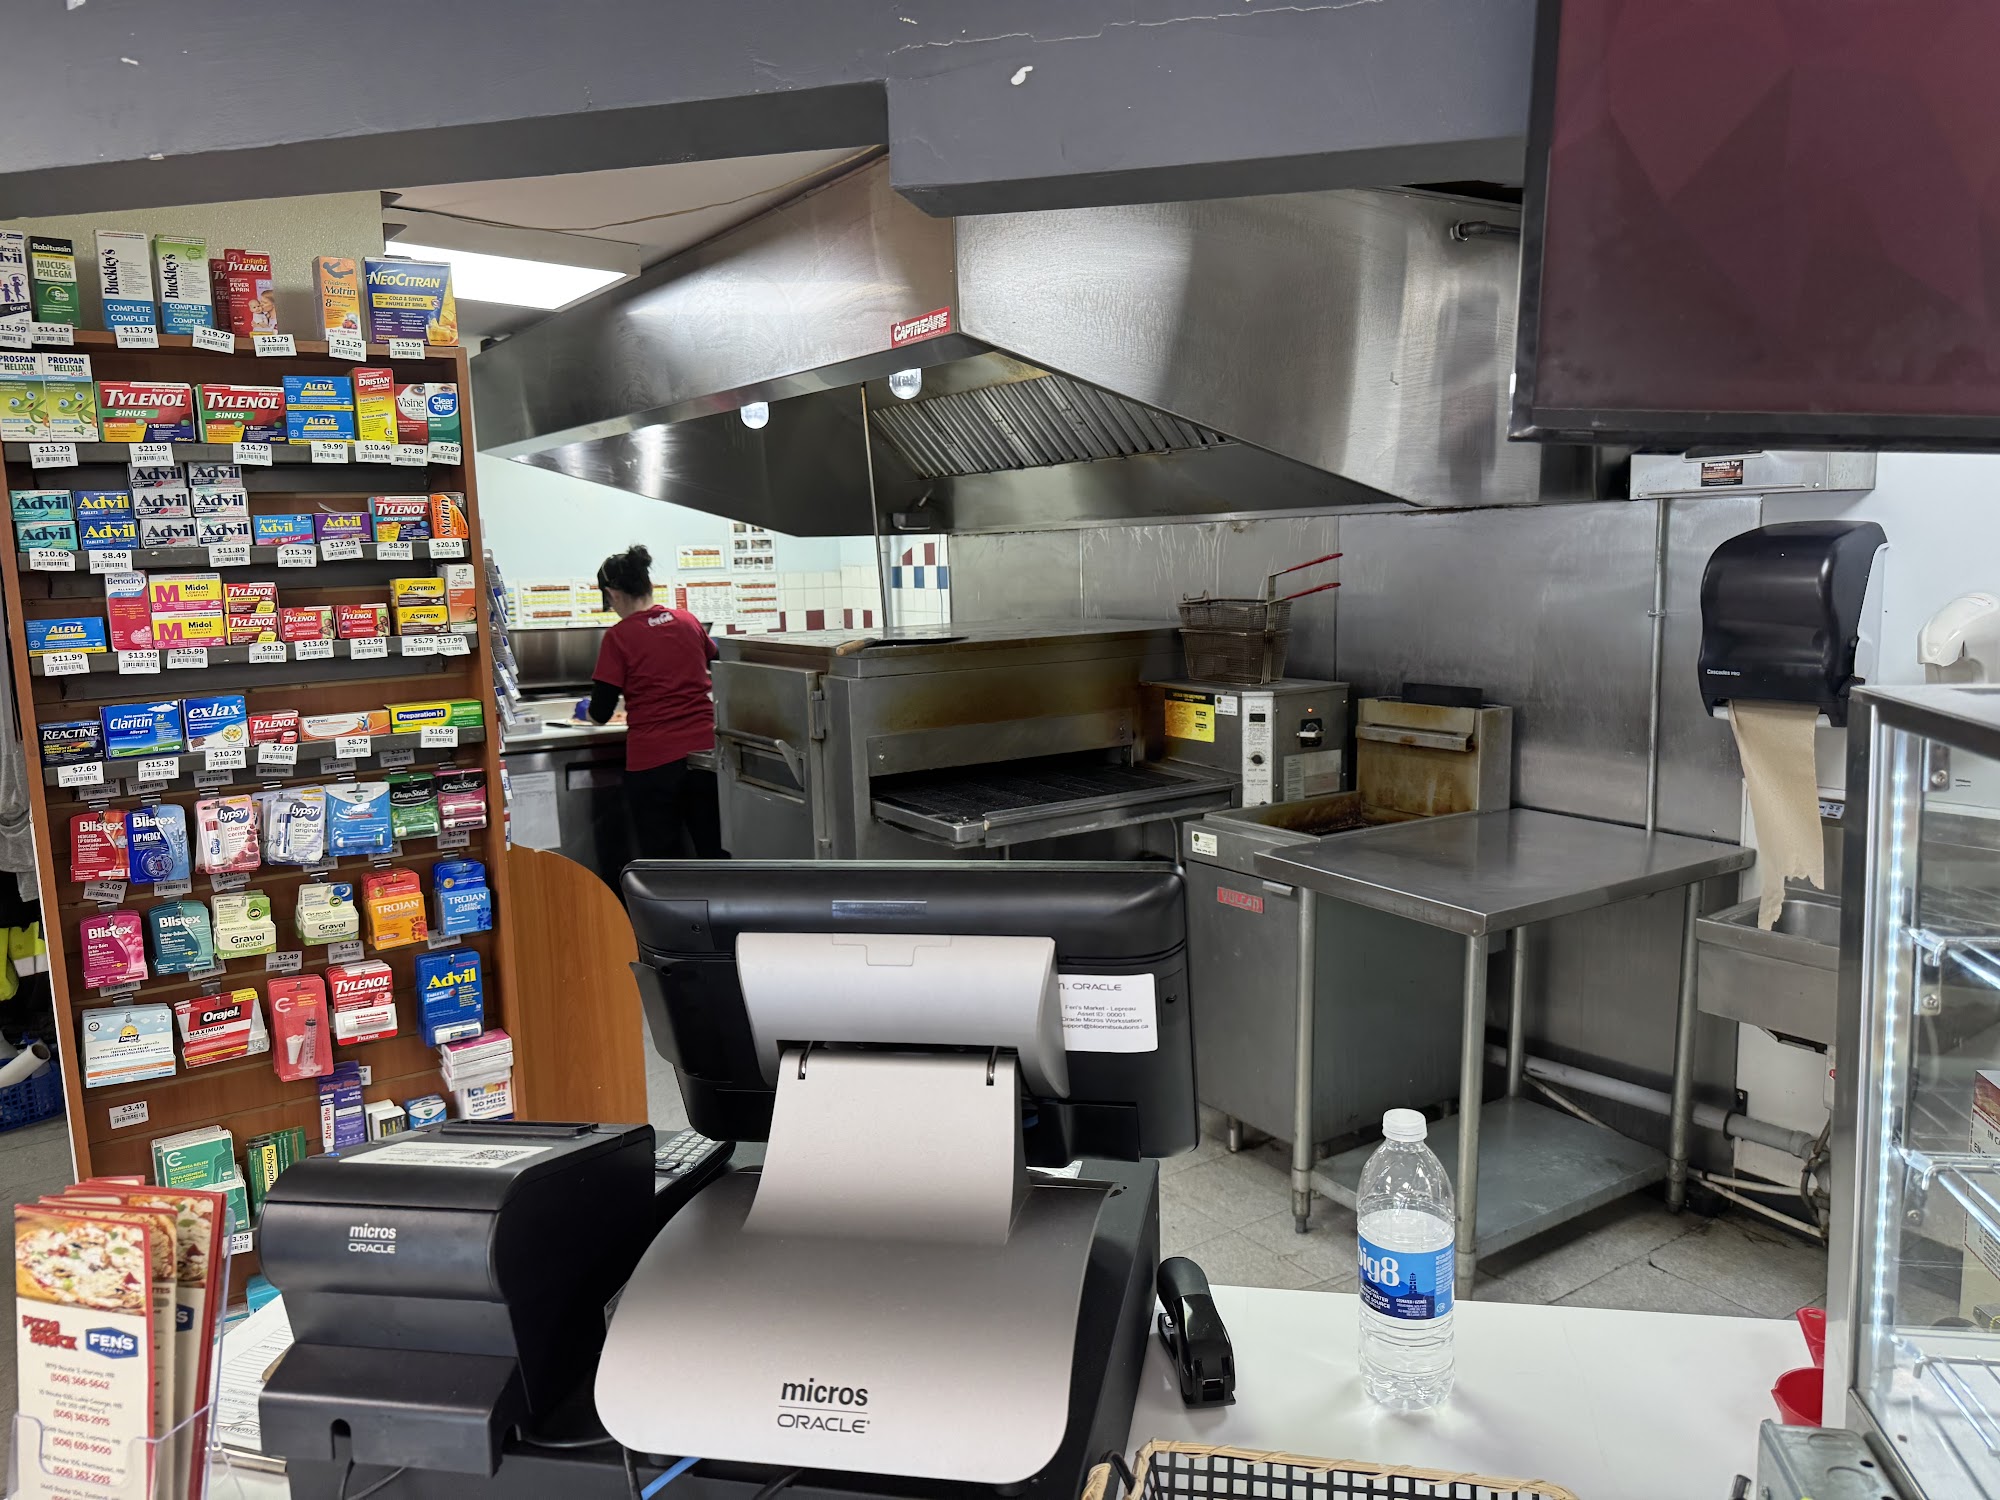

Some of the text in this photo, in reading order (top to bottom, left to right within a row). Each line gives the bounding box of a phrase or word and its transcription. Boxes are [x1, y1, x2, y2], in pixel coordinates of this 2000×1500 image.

[32, 243, 72, 253] Robitussin
[37, 260, 66, 270] MUCUS
[227, 261, 269, 272] TYLENOL
[38, 269, 72, 279] PHLEGM
[102, 249, 119, 295] Buckley's
[160, 254, 179, 299] Buckley's
[324, 286, 356, 296] Motrin
[107, 304, 151, 313] COMPLETE
[169, 303, 207, 311] COMPLETE
[111, 314, 150, 323] COMPLET
[172, 317, 206, 325] COMPLET
[124, 326, 153, 334] $13.79
[202, 329, 231, 340] $19.79
[336, 340, 362, 348] $13.29
[47, 356, 85, 365] PROSPAN
[4, 363, 35, 371] HELIXIA
[53, 364, 83, 372] HELIXIA
[303, 381, 334, 392] ALEVE
[358, 377, 390, 387] DRISTAN
[104, 389, 185, 407] TYLENOL
[205, 392, 279, 410] TYLENOL
[397, 397, 424, 408] Visine
[431, 396, 454, 405] Clear
[434, 403, 453, 412] eyes
[306, 416, 337, 425] ALEVE
[133, 466, 182, 480] Advil
[193, 466, 240, 479] Advil
[14, 496, 69, 509] Advil
[78, 495, 130, 509] Advil
[138, 493, 189, 507] Advil
[197, 494, 244, 506] Advil
[376, 503, 426, 515] TYLENOL
[322, 515, 361, 527] Advil
[440, 499, 451, 537] Motrin
[83, 524, 137, 538] Advil
[145, 523, 196, 538] Advil
[203, 523, 249, 536] Advil
[258, 522, 294, 533] Advil
[20, 527, 72, 540] Advil
[330, 540, 356, 549] $17.99
[107, 577, 144, 588] Benadryl
[185, 583, 209, 591] Midol
[155, 584, 180, 603] M
[228, 587, 273, 597] TYLENOL
[188, 621, 212, 629] Midol
[229, 617, 275, 627] TYLENOL
[284, 615, 317, 624] TYLENOL
[49, 625, 84, 634] ALEVE
[158, 622, 183, 641] M
[302, 640, 329, 648] $13.69
[438, 637, 463, 645] $17.99
[52, 654, 83, 663] $11.99
[399, 710, 437, 720] Preparation
[110, 716, 153, 730] Claritin
[252, 718, 297, 730] TYLENOL
[42, 728, 99, 741] REACTINE
[347, 738, 368, 746] $8.79
[214, 750, 242, 758] $10.29
[72, 765, 97, 774] $7.69
[145, 760, 175, 768] $15.39
[442, 782, 480, 791] ChapStick
[392, 788, 430, 800] ChapStick
[219, 807, 249, 821] lypsyl
[291, 804, 322, 819] lypsyl
[79, 821, 124, 832] Blistex
[132, 815, 176, 830] Blistex
[227, 825, 248, 833] cherry
[133, 831, 162, 842] LIP MEDEX
[98, 882, 123, 891] $3.09
[447, 892, 486, 905] TROJAN
[375, 899, 419, 914] TROJAN
[158, 915, 202, 928] Blistex
[318, 921, 346, 931] Gravol
[87, 924, 133, 939] Blistex
[230, 932, 266, 944] Gravol
[235, 941, 262, 949] GINGER
[278, 953, 299, 961] $2.49
[426, 967, 477, 990] Advil
[334, 975, 390, 994] TYLENOL
[1072, 983, 1122, 991] ORACLE
[189, 1025, 225, 1037] MAXIMUM
[357, 1033, 379, 1041] TYLENOL
[321, 1081, 343, 1092] After
[467, 1087, 485, 1098] ICY
[472, 1091, 506, 1102] MEDICATED
[486, 1096, 506, 1105] MESS
[122, 1103, 145, 1113] $3.49
[472, 1102, 506, 1113] APPLICATOR
[170, 1170, 204, 1180] SOULAGEMENT
[349, 1223, 397, 1239] micros
[348, 1243, 396, 1254] ORACLE
[89, 1333, 134, 1351] FEN'S
[780, 1377, 869, 1407] micros
[777, 1413, 866, 1434] ORACLE
